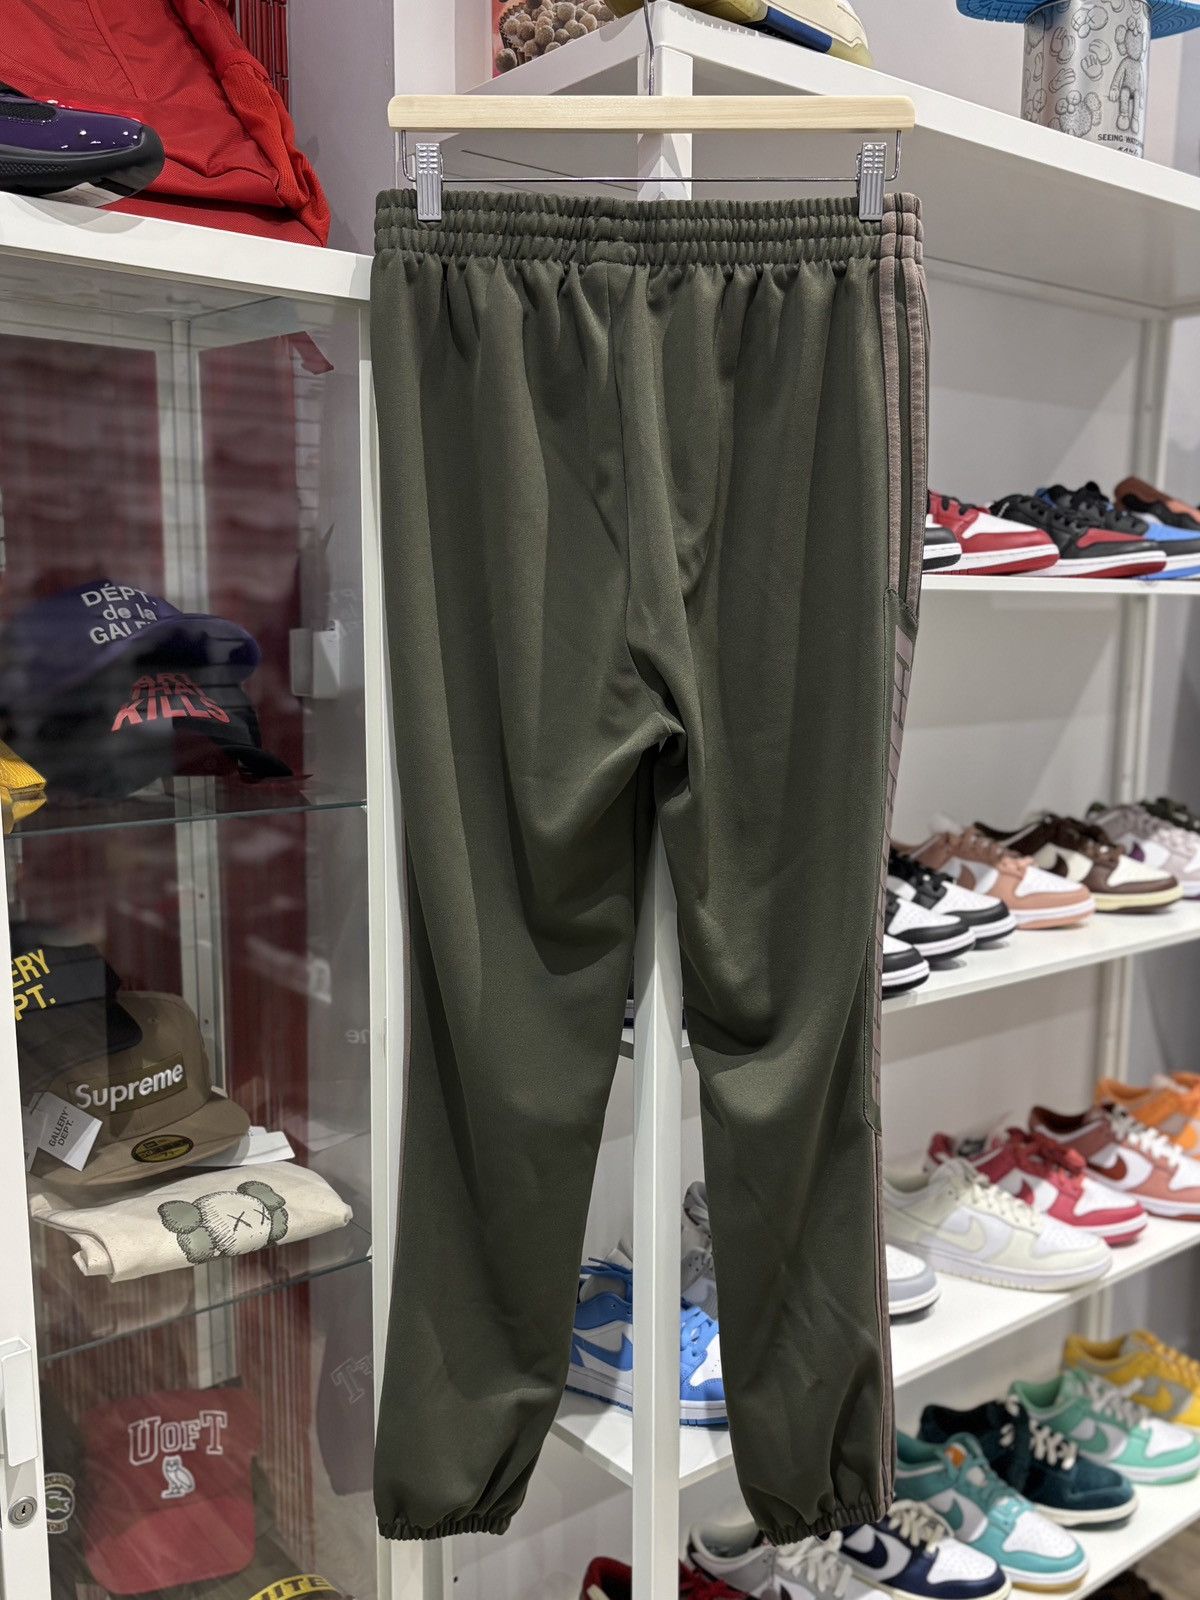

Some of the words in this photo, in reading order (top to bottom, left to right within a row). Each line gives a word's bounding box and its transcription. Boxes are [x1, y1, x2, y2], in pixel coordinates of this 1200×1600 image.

[1097, 133, 1124, 142] SEEING
[81, 583, 157, 607] DÉPT.
[102, 604, 132, 620] de
[135, 603, 158, 621] la
[111, 695, 230, 732] KILLS
[75, 1063, 184, 1112] Supreme
[58, 1119, 75, 1146] DEPT.
